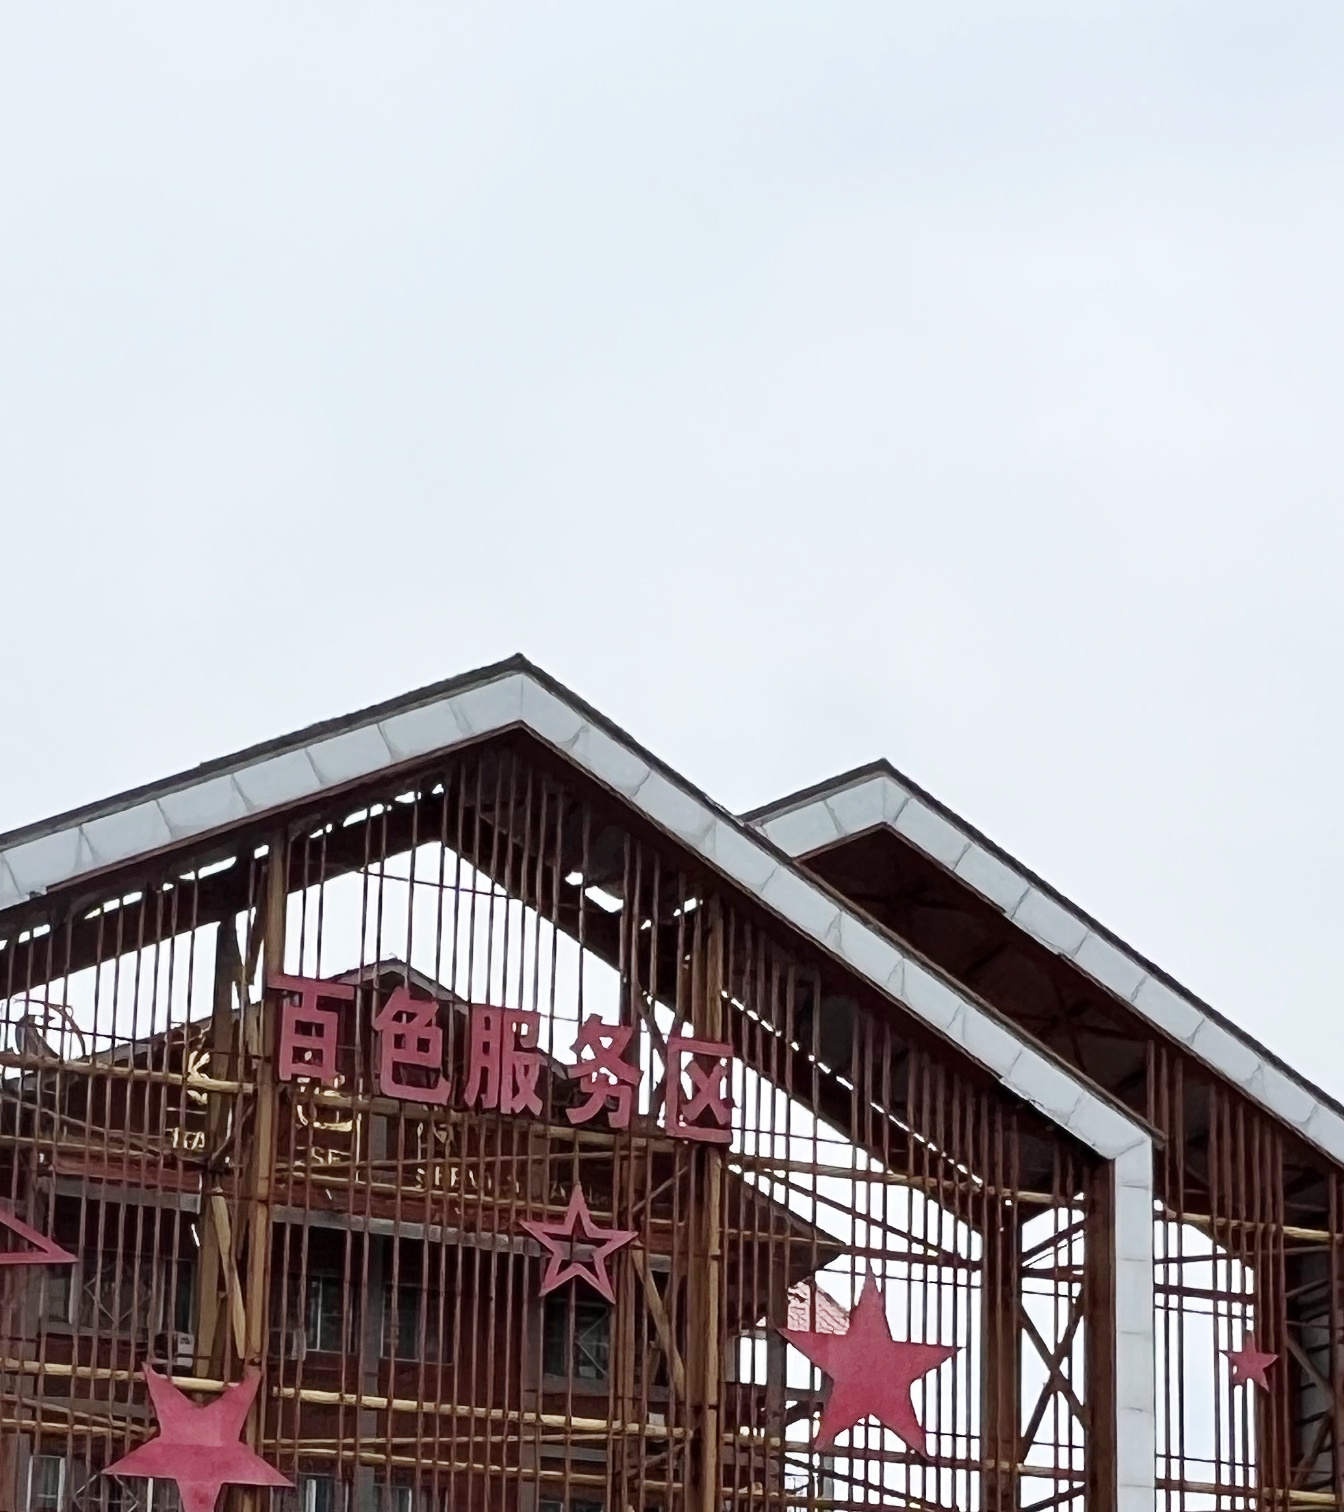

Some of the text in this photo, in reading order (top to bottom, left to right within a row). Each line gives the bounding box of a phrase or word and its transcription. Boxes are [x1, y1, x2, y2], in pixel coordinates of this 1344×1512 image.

[267, 973, 735, 1144] 百色服务区
